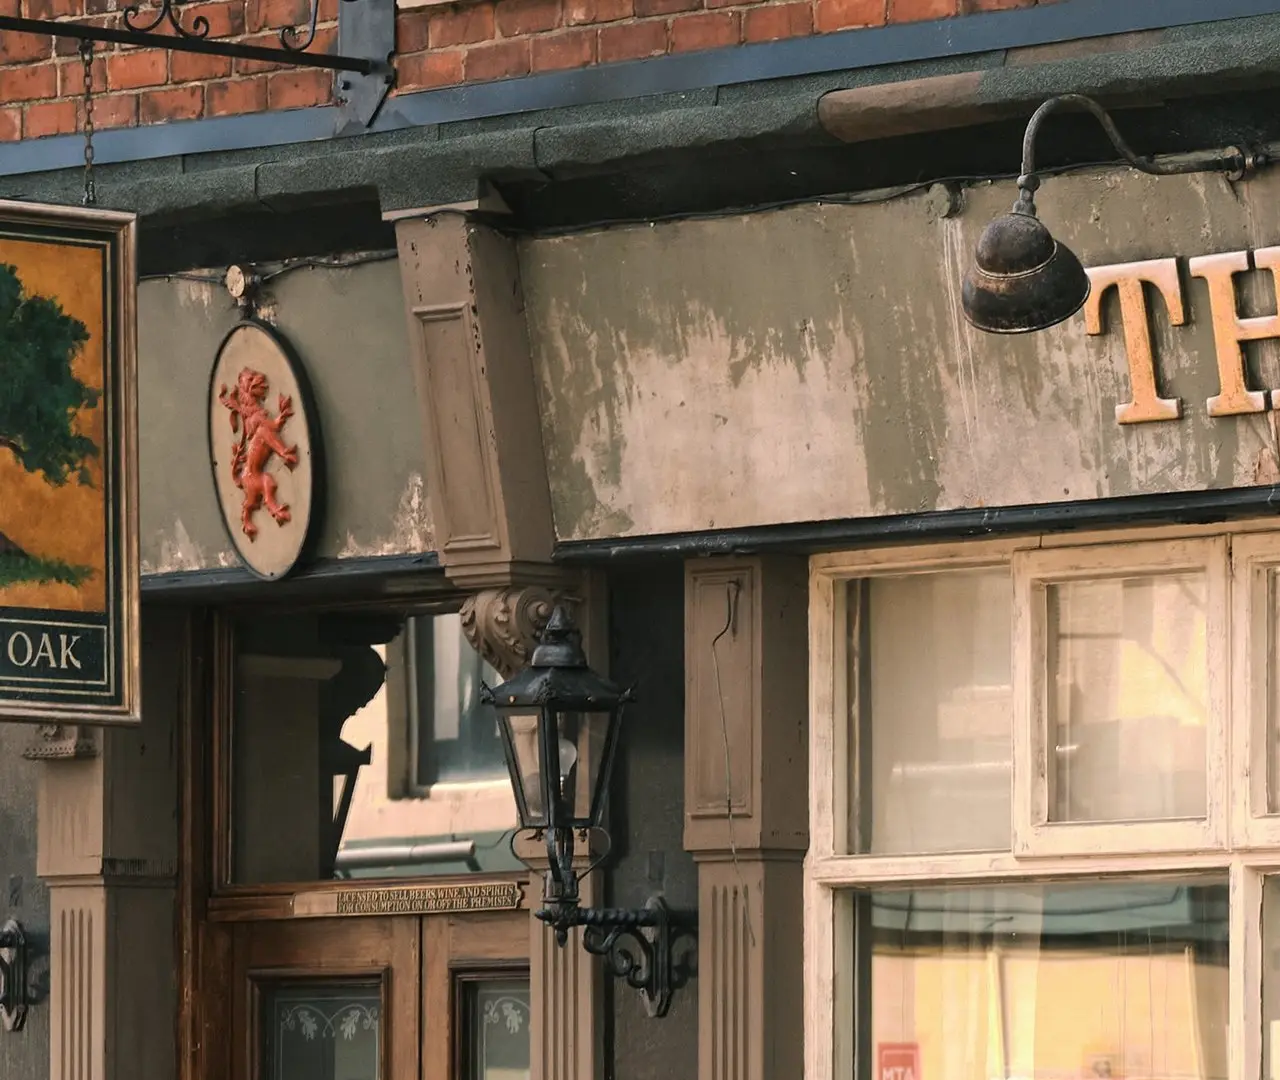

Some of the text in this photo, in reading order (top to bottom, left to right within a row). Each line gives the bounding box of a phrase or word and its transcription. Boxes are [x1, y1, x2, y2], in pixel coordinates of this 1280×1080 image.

[7, 631, 81, 669] OAK
[338, 890, 377, 903] LICENSED
[378, 889, 389, 901] TO
[390, 888, 408, 901] SELL
[461, 885, 479, 898] AND
[480, 883, 513, 896] SPIRITS
[452, 897, 469, 909] THE
